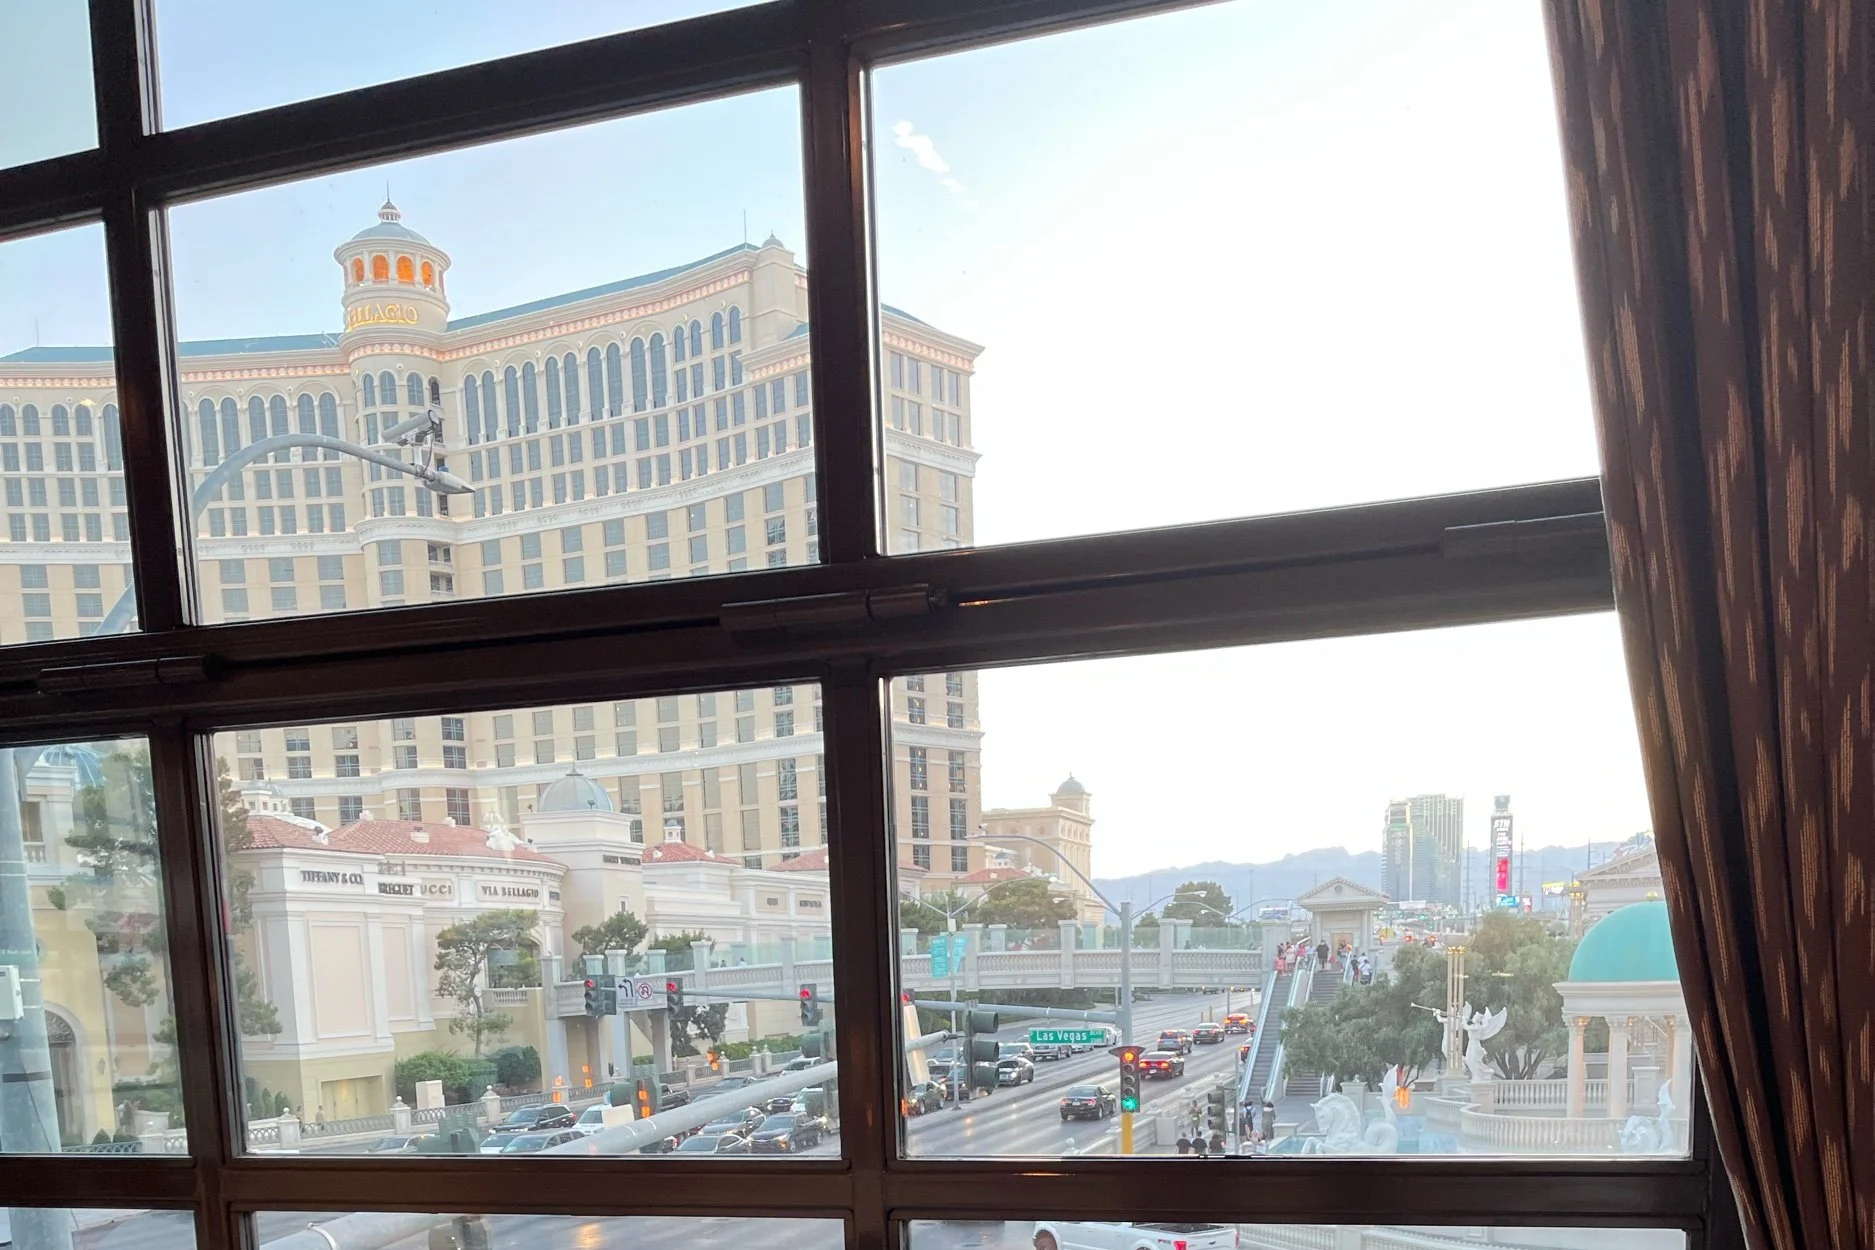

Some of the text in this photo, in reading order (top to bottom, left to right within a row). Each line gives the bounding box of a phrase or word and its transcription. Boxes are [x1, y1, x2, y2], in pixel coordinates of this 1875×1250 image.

[300, 870, 340, 884] TIFFANY
[341, 872, 349, 884] &
[420, 884, 452, 895] UCCI
[481, 885, 498, 896] VIA
[501, 886, 539, 898] BELLAGIO
[1036, 1031, 1054, 1041] Las
[1057, 1030, 1087, 1044] Vegas
